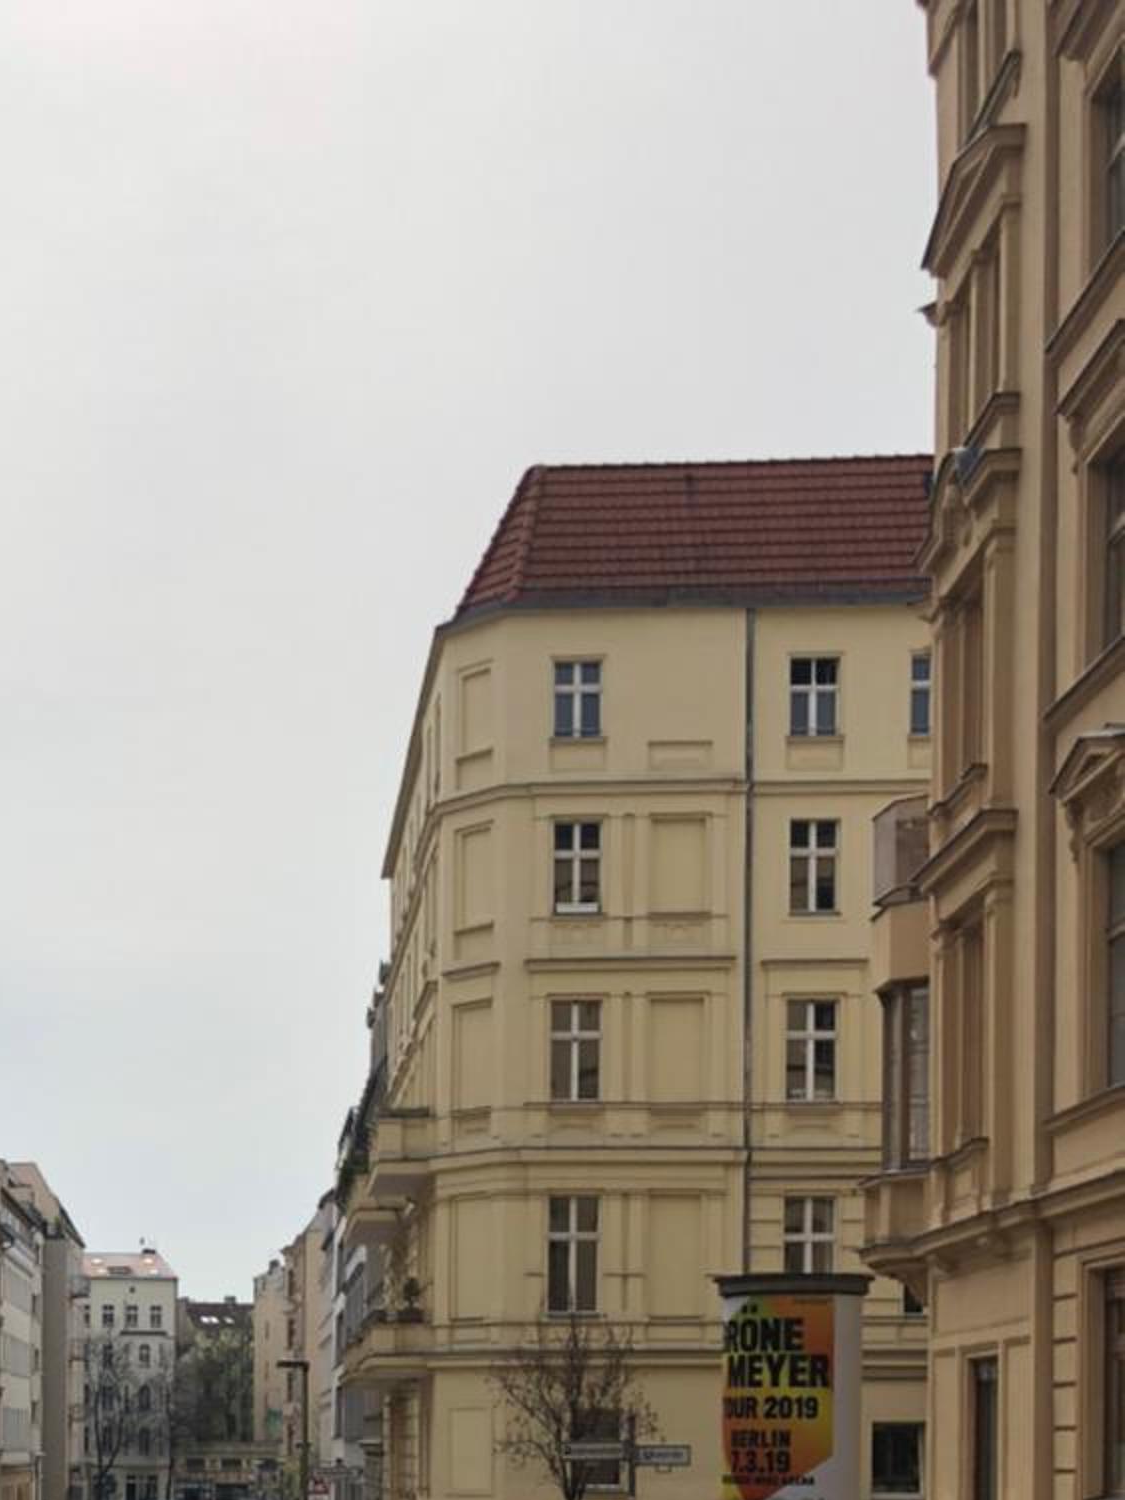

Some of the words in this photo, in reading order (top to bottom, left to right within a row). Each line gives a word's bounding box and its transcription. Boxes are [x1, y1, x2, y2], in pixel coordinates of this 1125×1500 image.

[728, 1354, 828, 1388] MEYER
[763, 1396, 819, 1420] 2019
[731, 1429, 791, 1448] BERLIN
